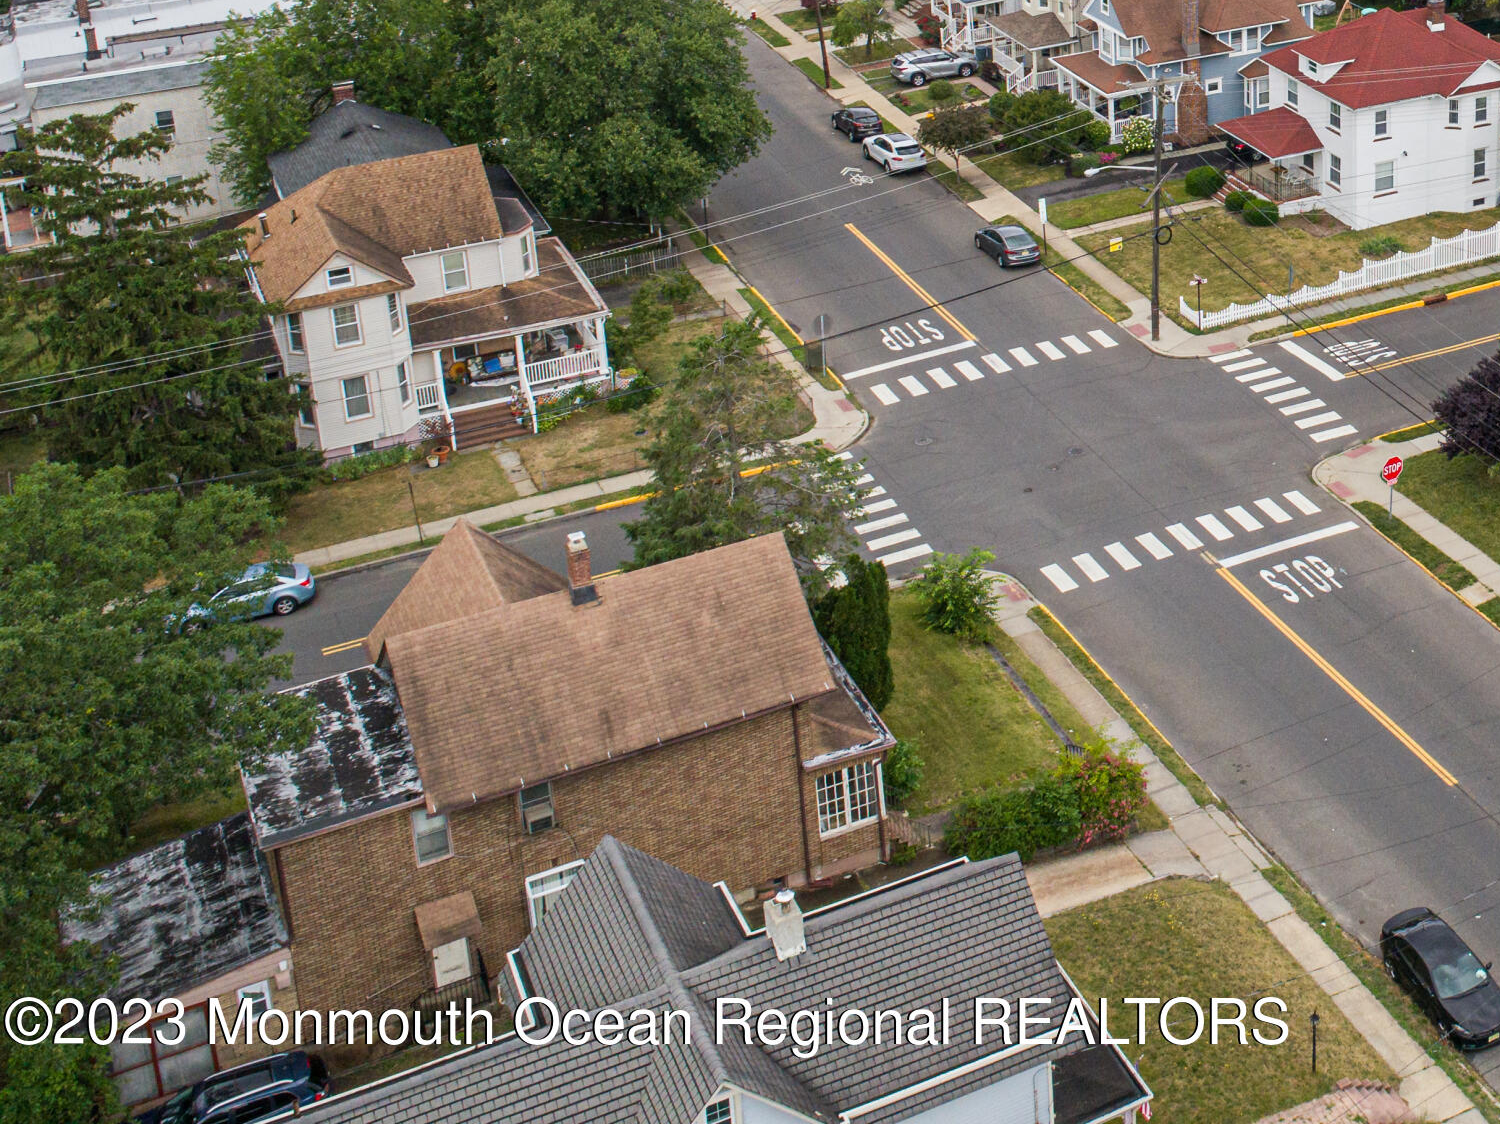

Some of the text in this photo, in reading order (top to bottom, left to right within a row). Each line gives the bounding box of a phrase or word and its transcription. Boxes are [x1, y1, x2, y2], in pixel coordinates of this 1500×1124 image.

[880, 319, 944, 351] STOP
[1323, 338, 1397, 366] STOP
[1384, 462, 1401, 476] STOP
[1259, 556, 1343, 603] STOP
